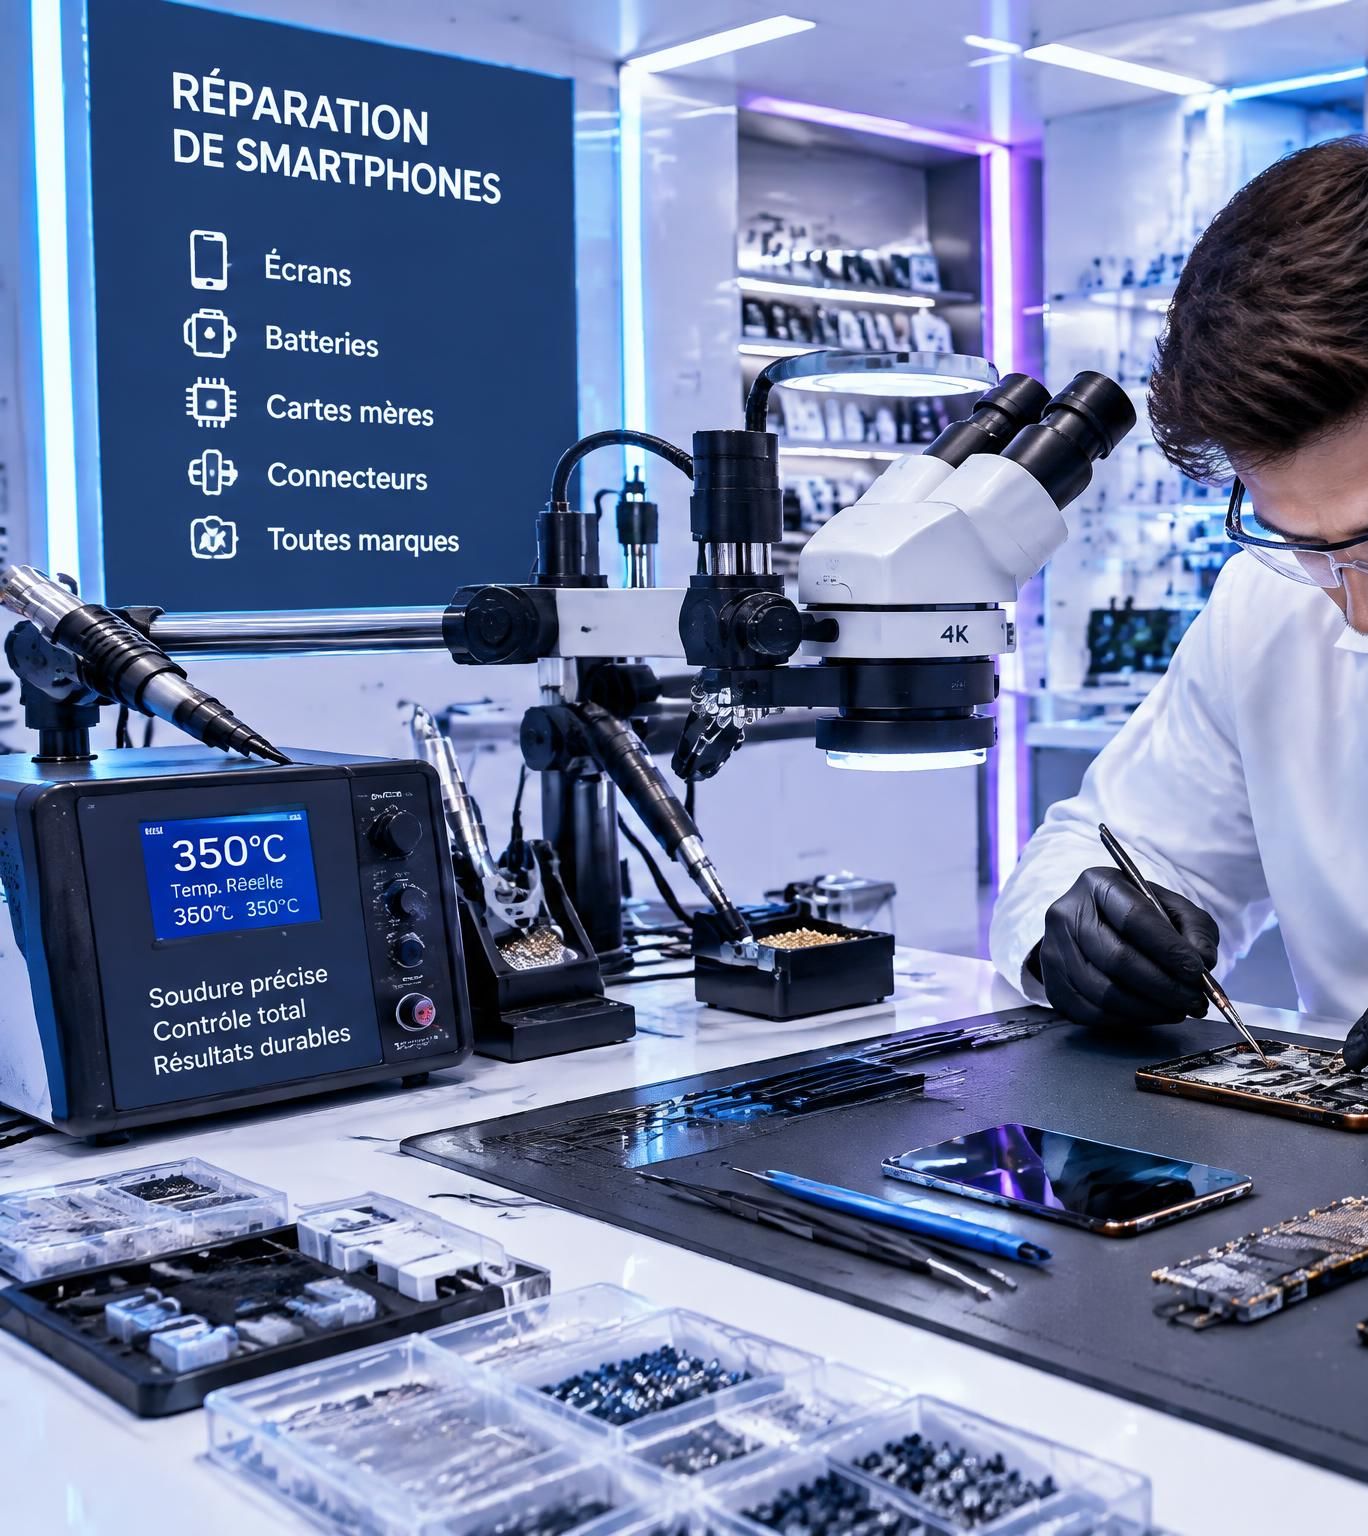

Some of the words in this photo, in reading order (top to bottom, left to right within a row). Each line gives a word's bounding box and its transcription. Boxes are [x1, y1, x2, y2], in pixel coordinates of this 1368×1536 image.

[172, 67, 428, 146] RÉPARATION
[173, 128, 225, 169] DE
[235, 137, 502, 205] SMARTPHONES
[265, 247, 352, 287] Écrans
[265, 324, 379, 358] Batteries
[266, 393, 352, 423] Cartes
[360, 399, 434, 427] mères
[267, 461, 428, 491] Connecteurs
[267, 527, 352, 551] Toutes
[358, 533, 460, 558] marques
[940, 624, 969, 644] 4K
[172, 833, 287, 872] 350°C
[170, 883, 222, 899] Temp.
[245, 897, 300, 917] 350°C
[149, 980, 244, 1009] Soudure
[250, 966, 328, 999] précise
[256, 997, 306, 1025] total
[153, 1043, 254, 1076] Résultats
[260, 1025, 351, 1057] durables
